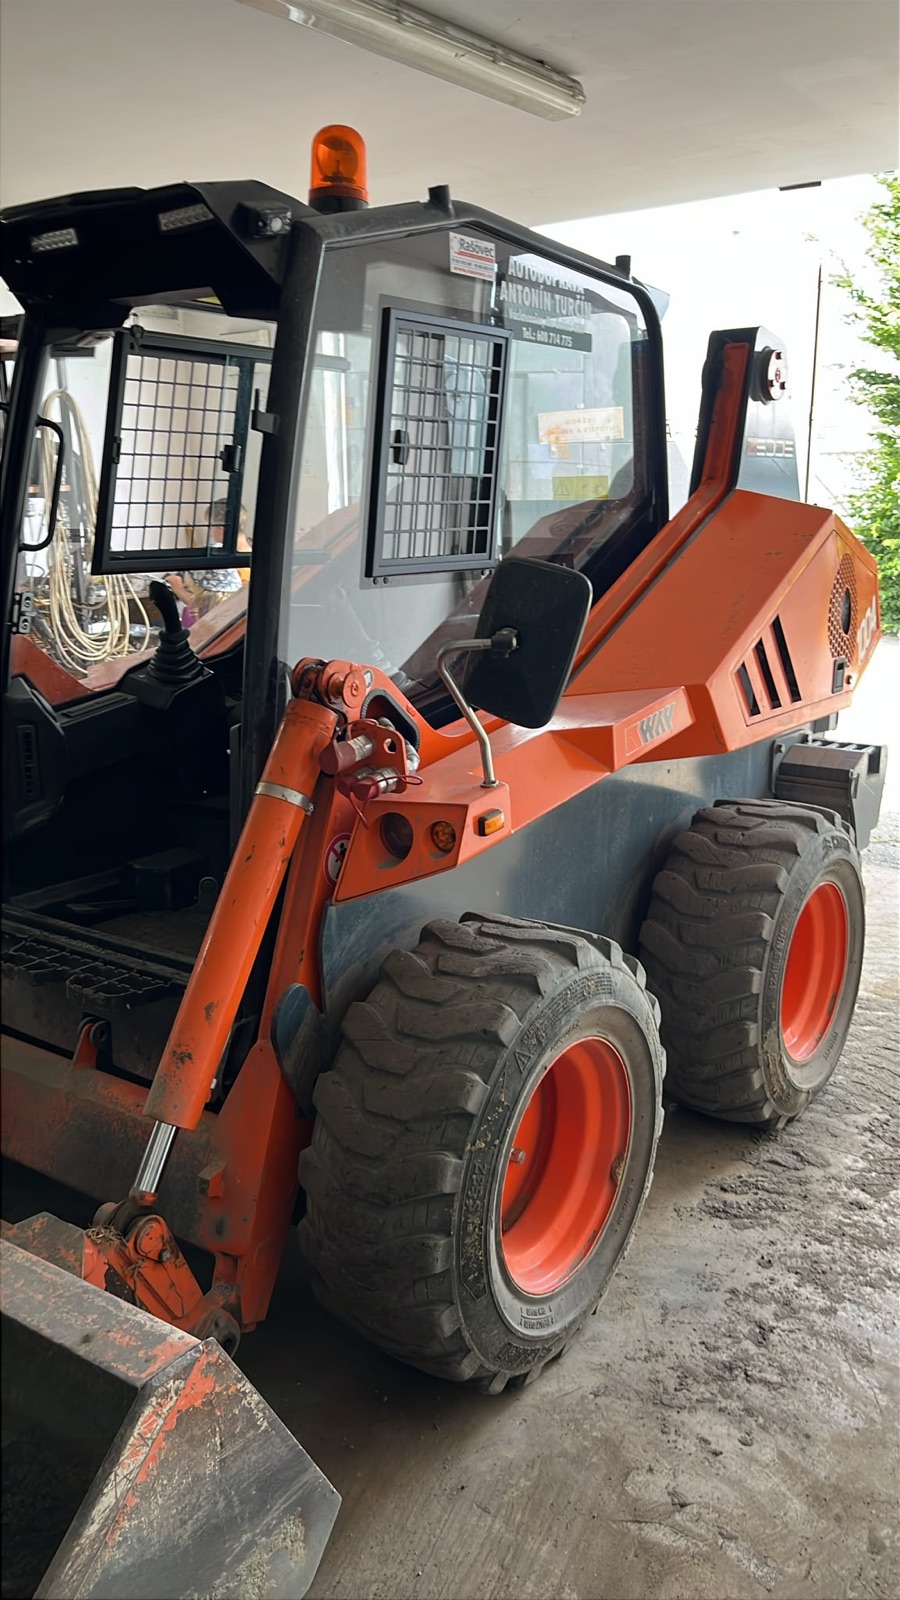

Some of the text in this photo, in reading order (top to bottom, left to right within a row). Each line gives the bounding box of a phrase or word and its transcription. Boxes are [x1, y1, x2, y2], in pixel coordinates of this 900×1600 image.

[459, 237, 494, 258] Rašovec
[500, 280, 552, 312] ANTONÍN
[639, 701, 676, 745] WAY
